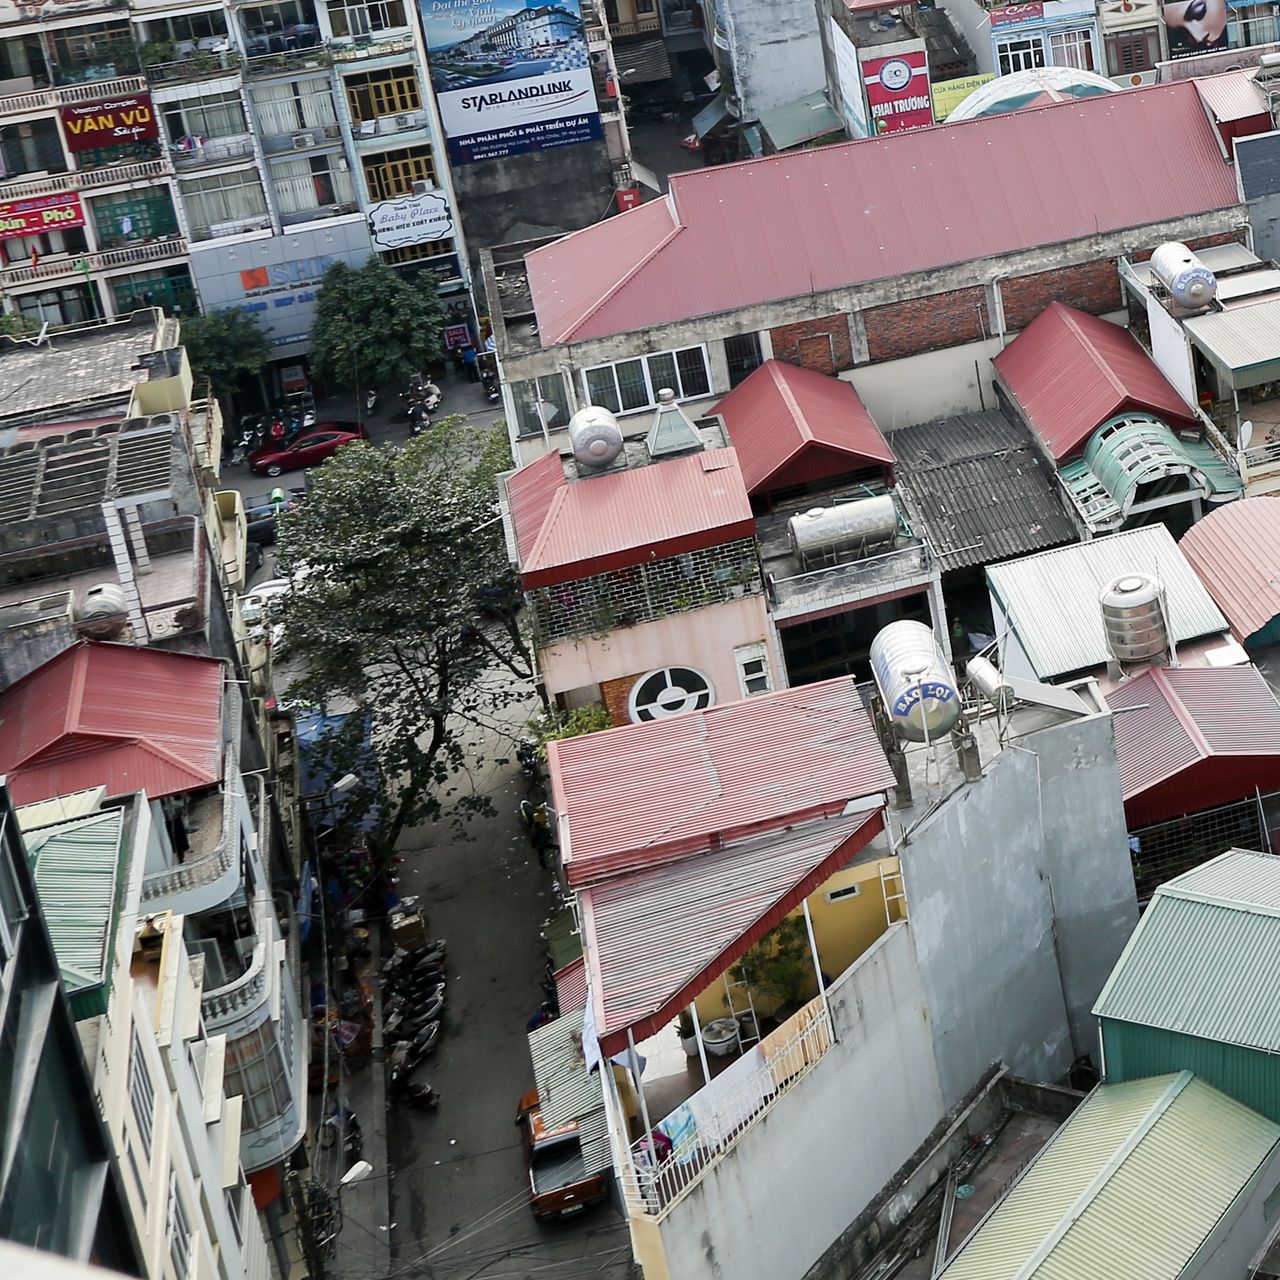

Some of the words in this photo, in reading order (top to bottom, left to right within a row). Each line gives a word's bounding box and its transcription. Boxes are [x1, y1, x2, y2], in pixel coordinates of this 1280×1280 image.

[461, 80, 573, 112] STARLANDLINK
[872, 103, 892, 118] KHAI
[42, 207, 76, 223] Phở
[380, 213, 407, 224] Baby
